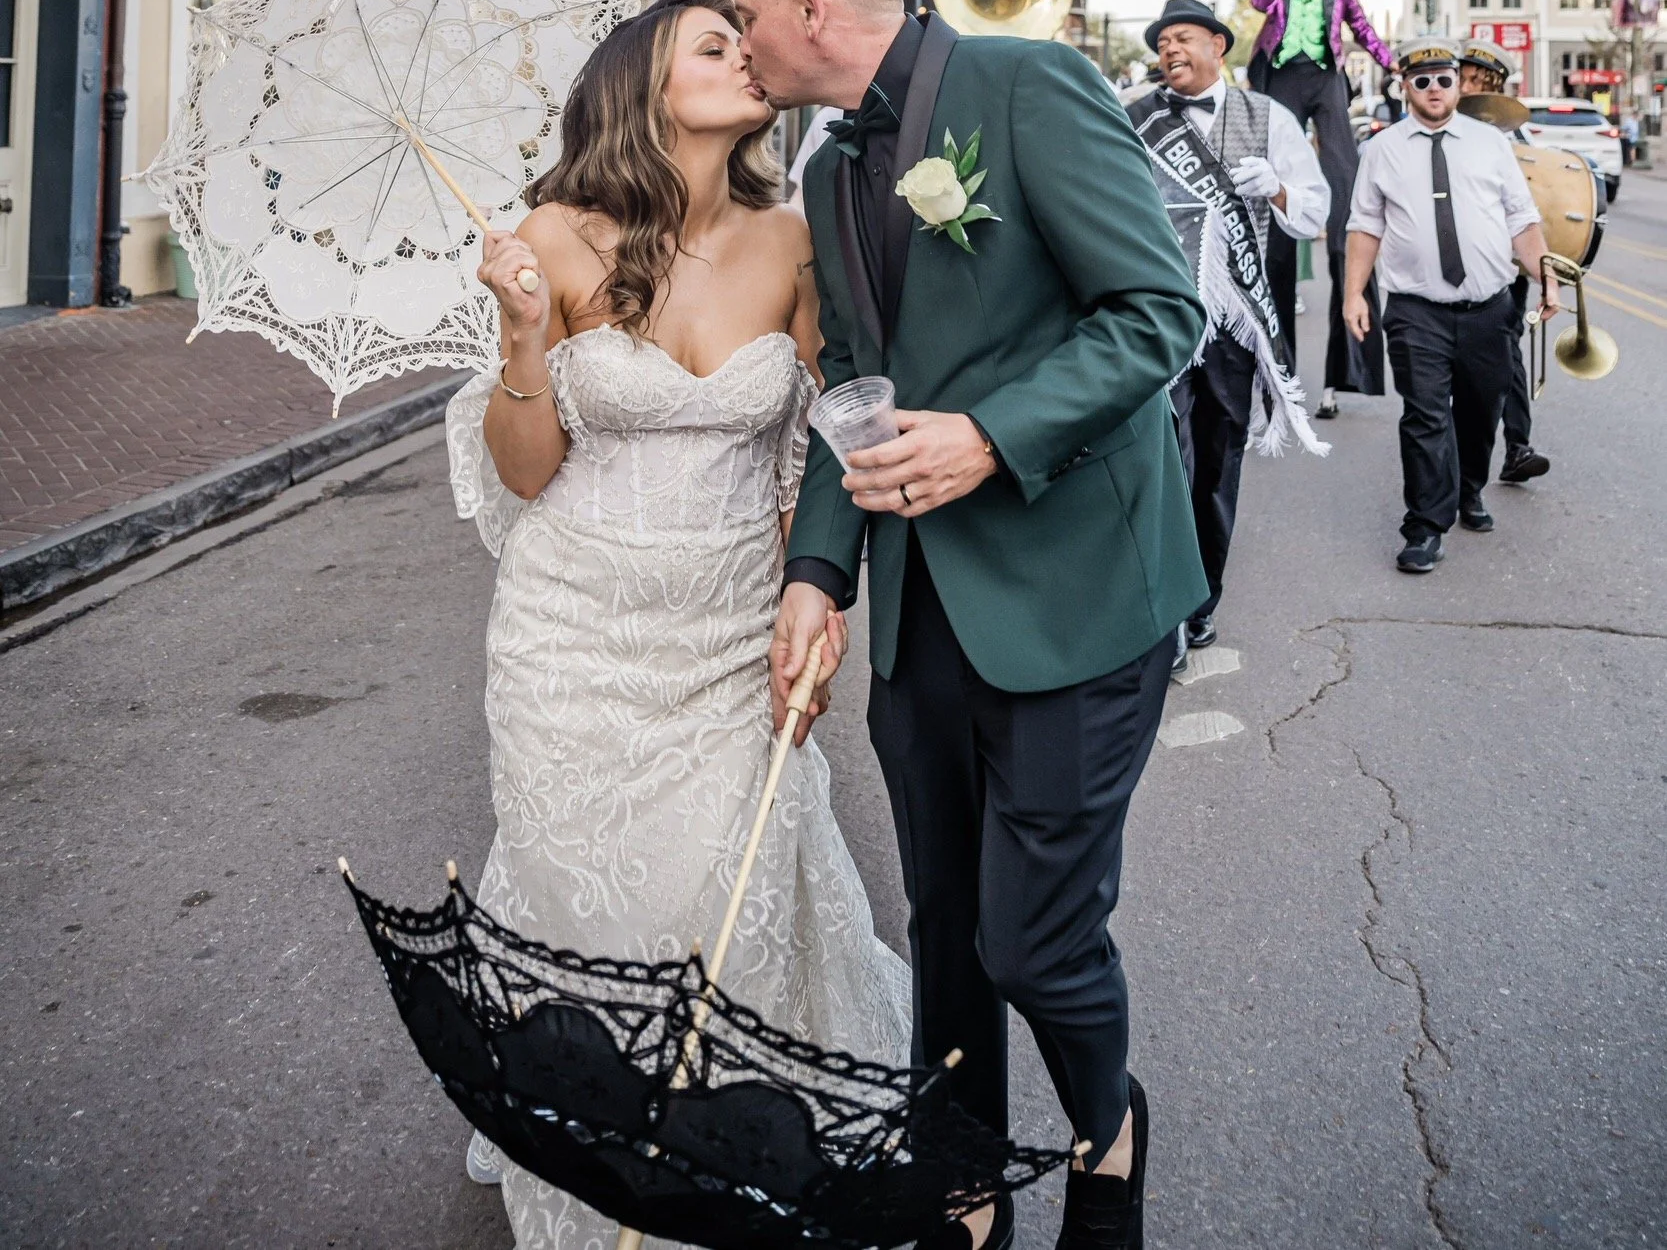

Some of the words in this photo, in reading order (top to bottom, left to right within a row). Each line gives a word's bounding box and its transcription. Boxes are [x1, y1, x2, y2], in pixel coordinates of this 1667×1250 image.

[1164, 139, 1202, 178] BIG
[1191, 173, 1232, 212] FUN
[1249, 279, 1280, 339] BAND
